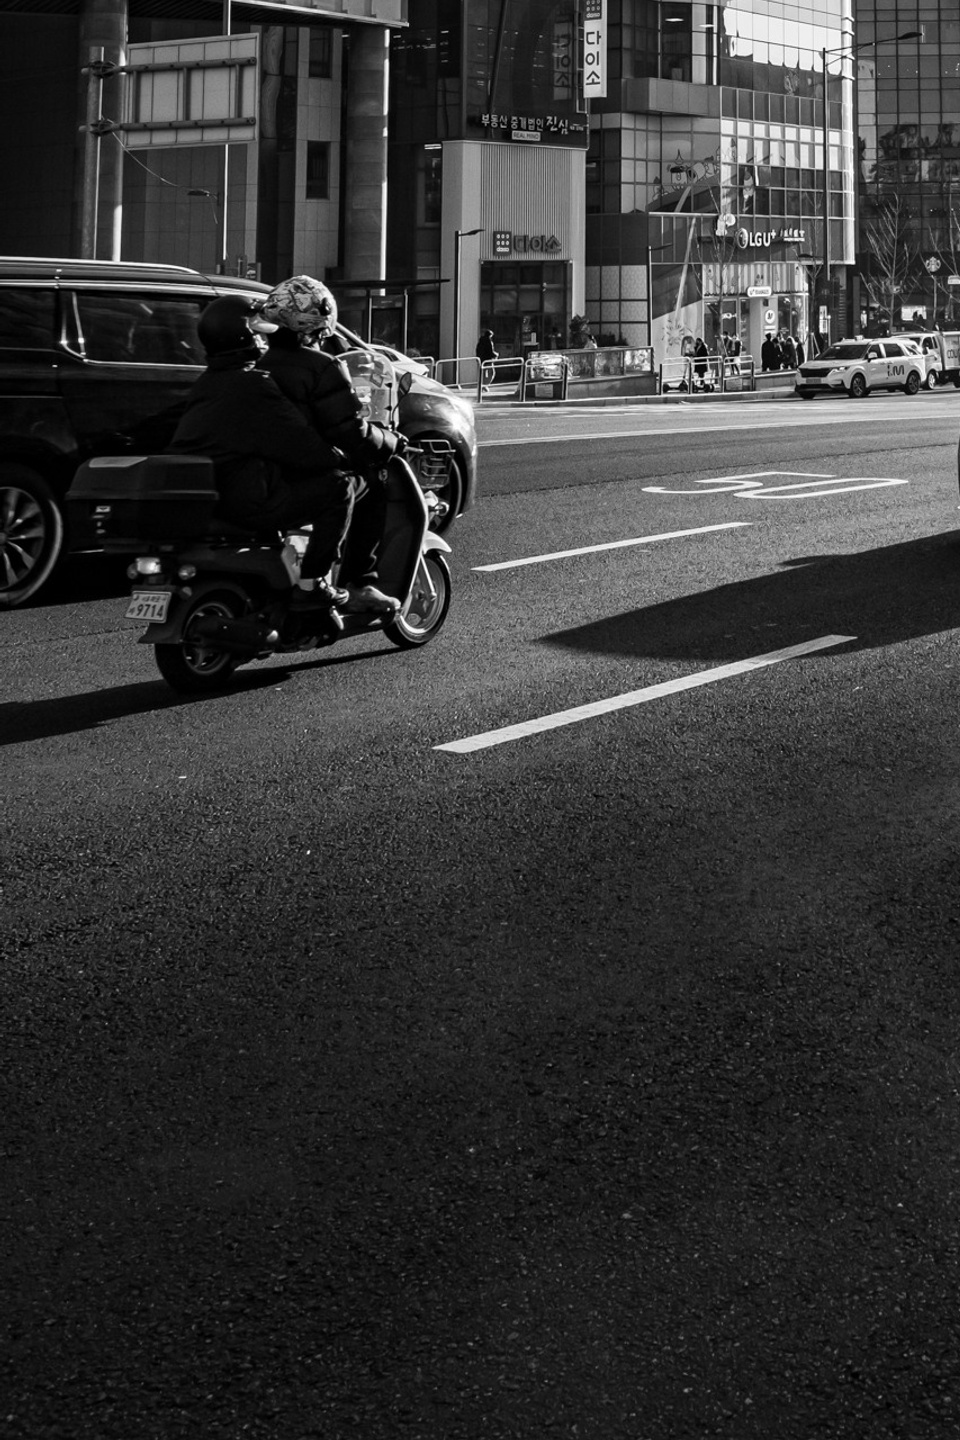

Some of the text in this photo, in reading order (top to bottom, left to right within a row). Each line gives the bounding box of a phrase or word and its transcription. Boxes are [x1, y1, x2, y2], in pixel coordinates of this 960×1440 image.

[585, 30, 602, 86] 다이소
[481, 113, 508, 129] 부동산
[510, 115, 544, 132] 중개법인
[546, 115, 569, 135] 진심
[513, 235, 562, 254] 다이소
[137, 603, 164, 618] 9714
